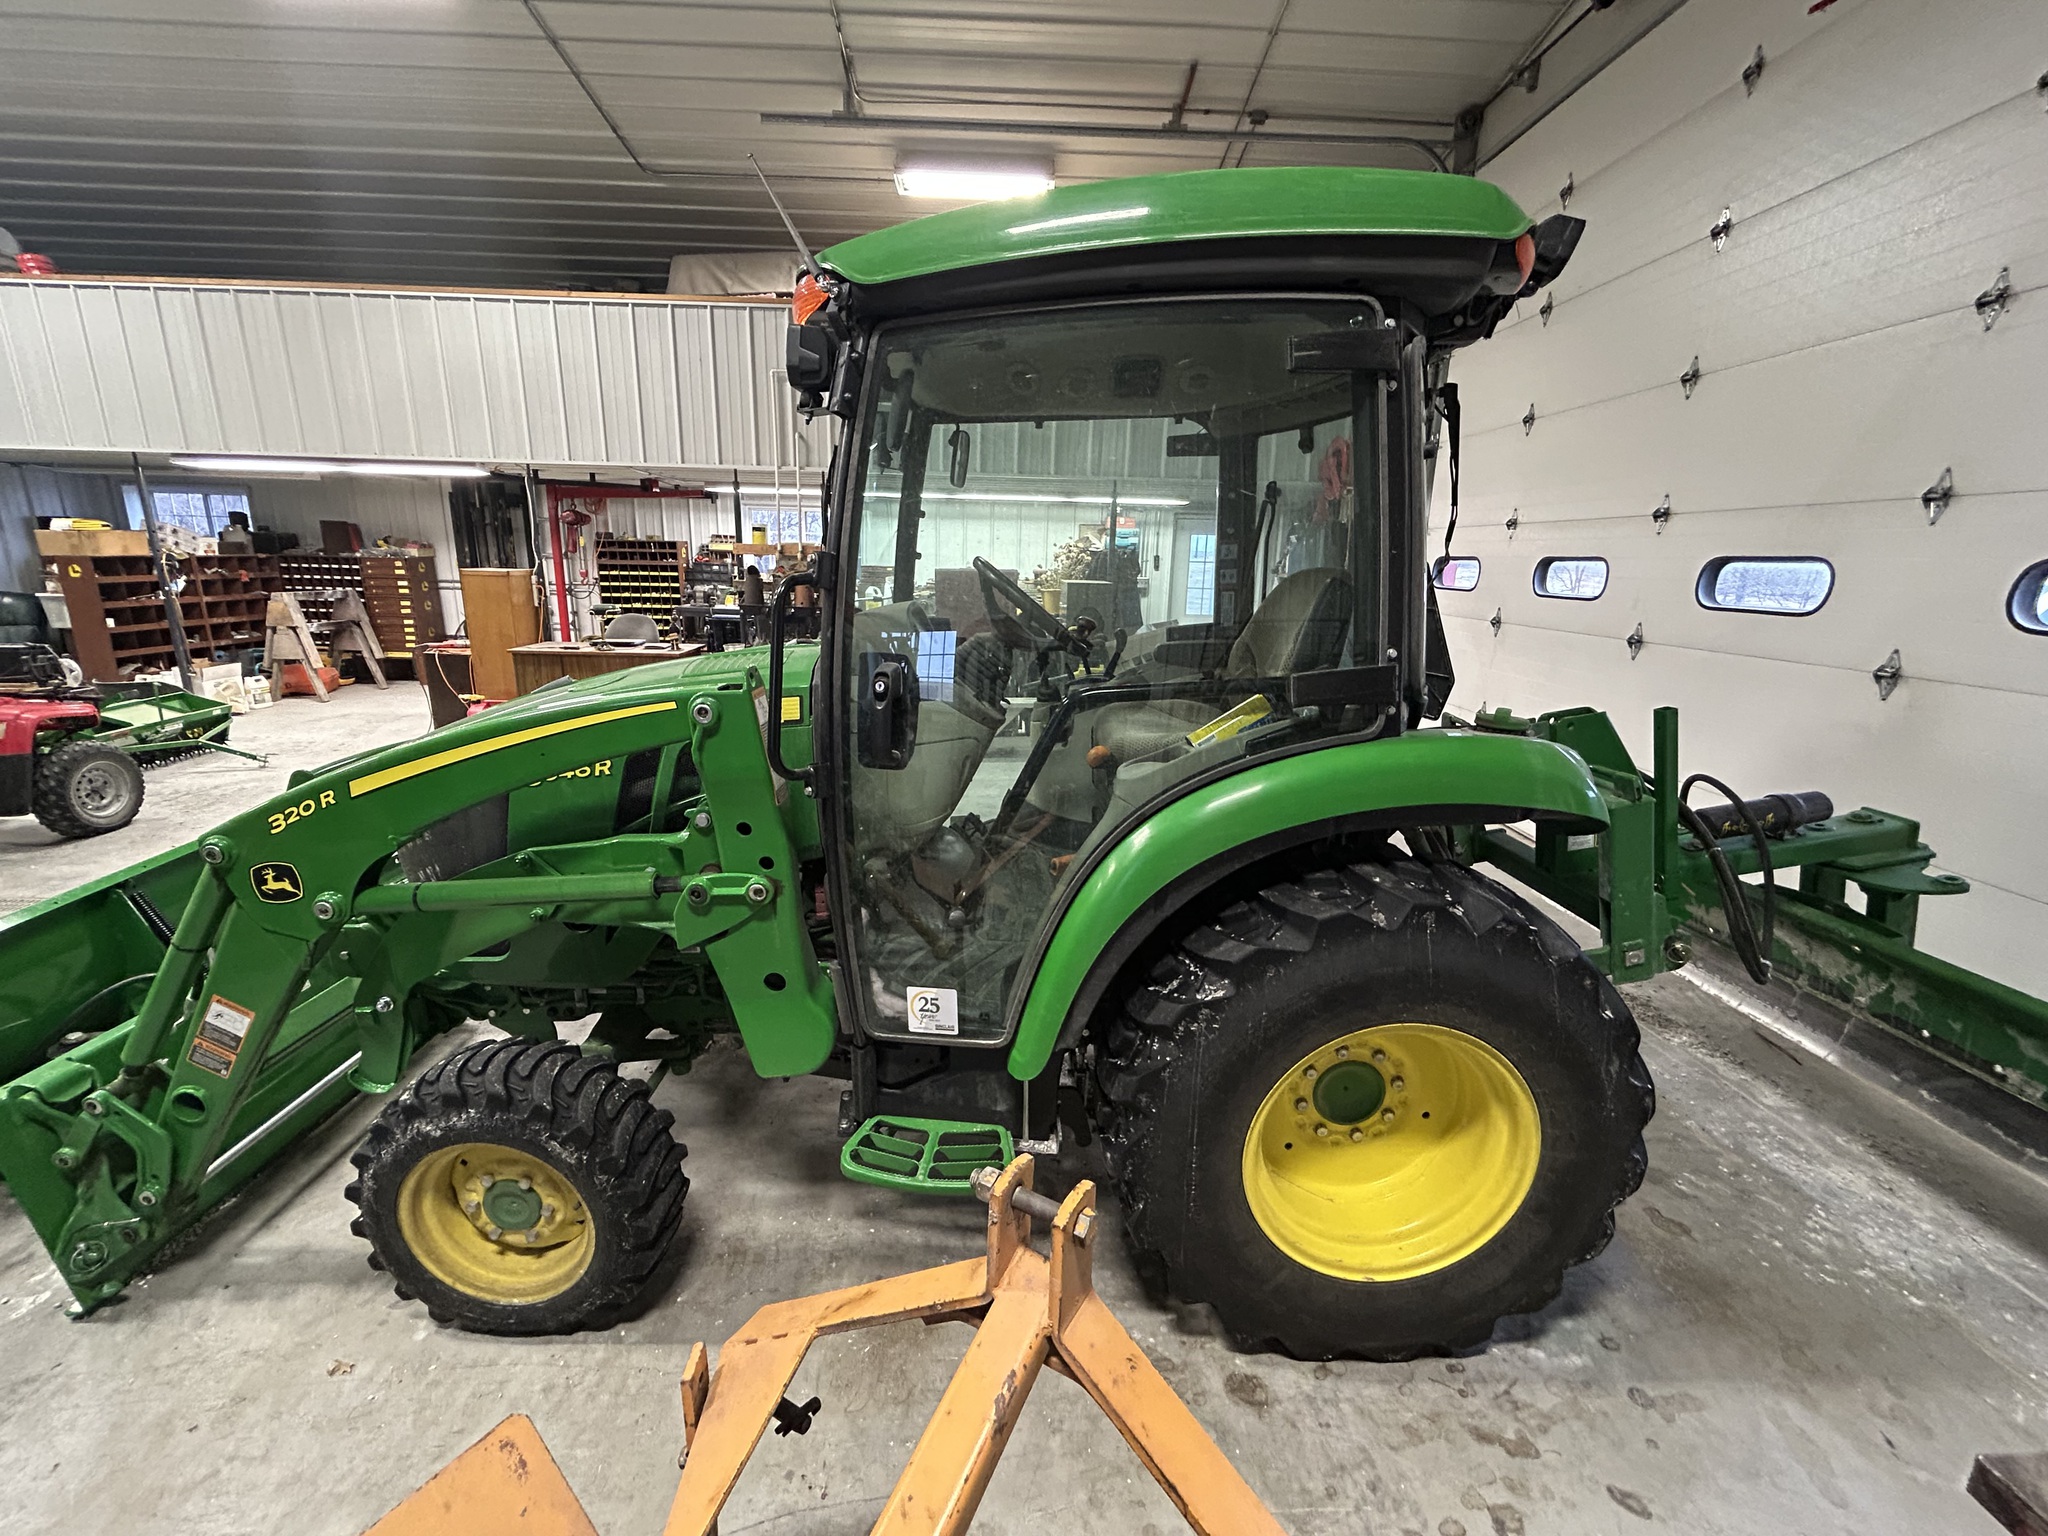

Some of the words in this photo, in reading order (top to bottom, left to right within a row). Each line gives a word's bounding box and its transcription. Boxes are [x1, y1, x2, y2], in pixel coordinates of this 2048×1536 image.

[594, 759, 612, 777] R
[268, 799, 316, 835] 320
[319, 789, 337, 809] R
[918, 996, 941, 1014] 25
